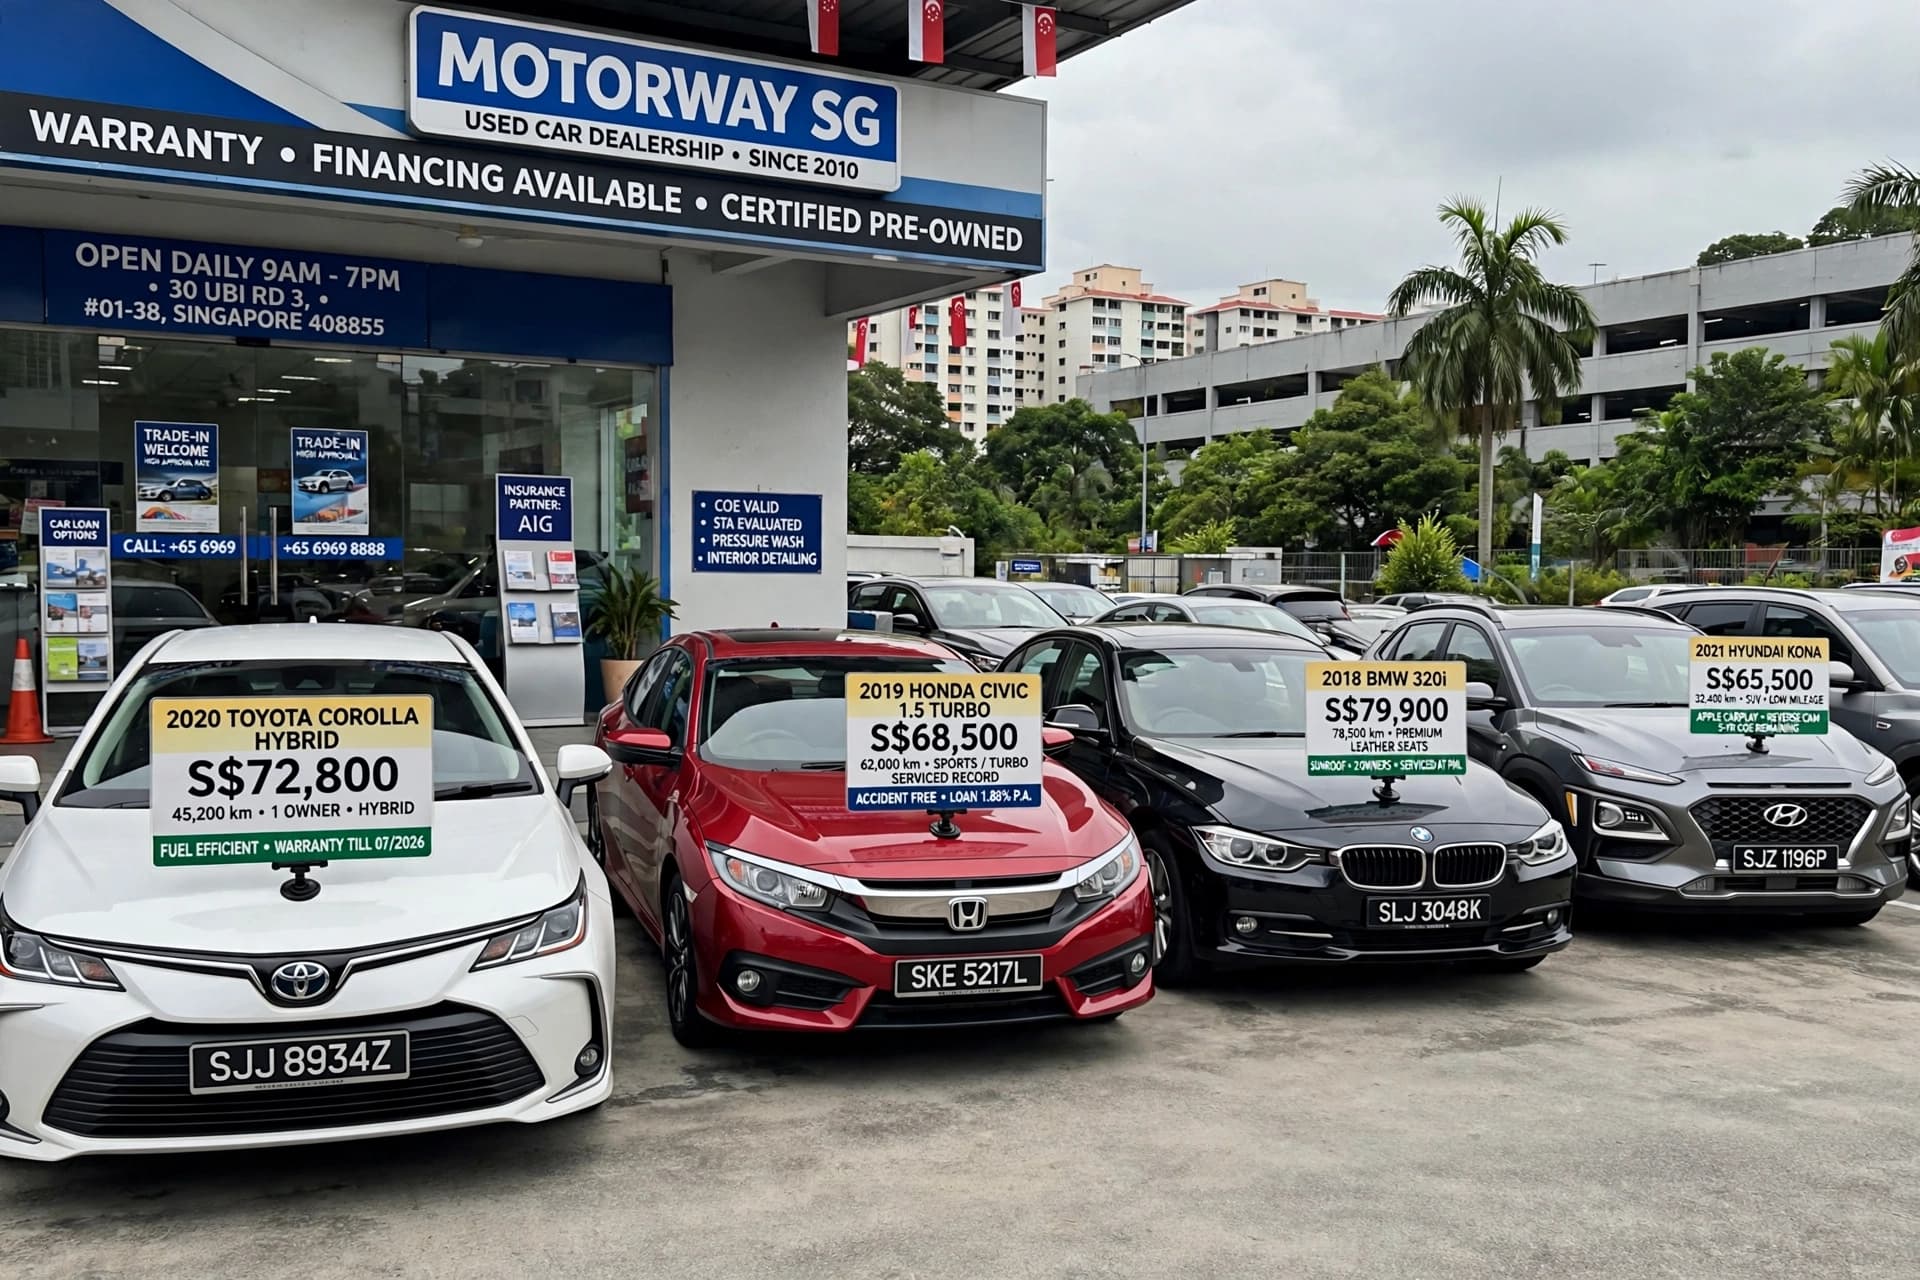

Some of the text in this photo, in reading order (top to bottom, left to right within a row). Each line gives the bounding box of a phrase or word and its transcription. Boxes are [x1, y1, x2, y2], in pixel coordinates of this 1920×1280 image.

[439, 32, 880, 146] MOTORWAY SG
[465, 110, 858, 179] USED CAR DEALERSHIP SINCE 2010
[28, 109, 1023, 251] WARRANTY FINANCING AVAILABLE CERTIFIED PRE-OWNED
[75, 242, 161, 272] OPEN
[172, 251, 254, 279] DAILY
[262, 259, 321, 285] 9AM
[345, 266, 400, 292] 7PM
[169, 279, 310, 311] 30 UBI RD 3,
[84, 298, 384, 336] #01-38, SINGAPORE 408855
[144, 428, 209, 443] TRADE-IN
[296, 436, 360, 450] TRADE-IN
[144, 443, 209, 457] WELCOME
[504, 485, 566, 497] INSURANCE
[509, 499, 561, 511] PARTNER:
[714, 499, 779, 514] COE VALID
[50, 520, 100, 529] CAR LOAN
[518, 515, 553, 532] AIG
[713, 516, 802, 531] STA EVALUATED
[53, 530, 97, 540] OPTIONS
[712, 534, 804, 549] PRESSURE WASH
[123, 539, 236, 554] CALL: +65 6969
[283, 541, 385, 556] +65 6969 8888
[707, 551, 817, 566] INTERIOR DETAILING
[1696, 644, 1822, 659] 2021 HYUNDAI KONA
[1322, 671, 1446, 686] 2018 BMW 320i
[1706, 666, 1813, 694] S$65,500
[859, 683, 1028, 699] 2019 HONDA CIVIC
[1725, 692, 1736, 702] km
[1746, 695, 1761, 704] SUV
[1769, 695, 1786, 704] LOW
[1790, 695, 1824, 704] MILEAGE
[899, 702, 990, 718] 1.5 TURBO
[1325, 695, 1448, 727] S$79,900
[1696, 712, 1721, 721] APPLE
[1723, 712, 1759, 722] CARPLAY
[166, 707, 419, 729] 2020 TOYOTA COROLLA
[1332, 728, 1442, 740] 78,500 km PREMIUM
[1737, 723, 1754, 733] COE
[255, 730, 339, 751] HYBRID
[871, 720, 1018, 755] S$68,500
[1351, 741, 1428, 752] LEATHER SEATS
[860, 758, 899, 772] 62,000
[903, 758, 920, 770] km
[934, 758, 978, 769] SPORTS
[989, 757, 1028, 768] TURBO
[188, 756, 398, 801] S$72,800
[892, 772, 1000, 784] SERVICED RECORD
[856, 792, 909, 805] ACCIDENT
[911, 791, 937, 804] FREE
[950, 790, 978, 803] LOAN
[1013, 790, 1032, 801] P.A.
[172, 801, 415, 824] 45,200 km 1 OWNER HYBRID
[160, 835, 425, 858] FUEL EFFICIENT WARRANTY TILL 07/2026
[1743, 849, 1827, 868] SJZ 1196P
[1379, 899, 1481, 922] SLJ 3048K
[912, 961, 1027, 988] SKE 5217L
[210, 1040, 391, 1081] SJJ 8934Z
